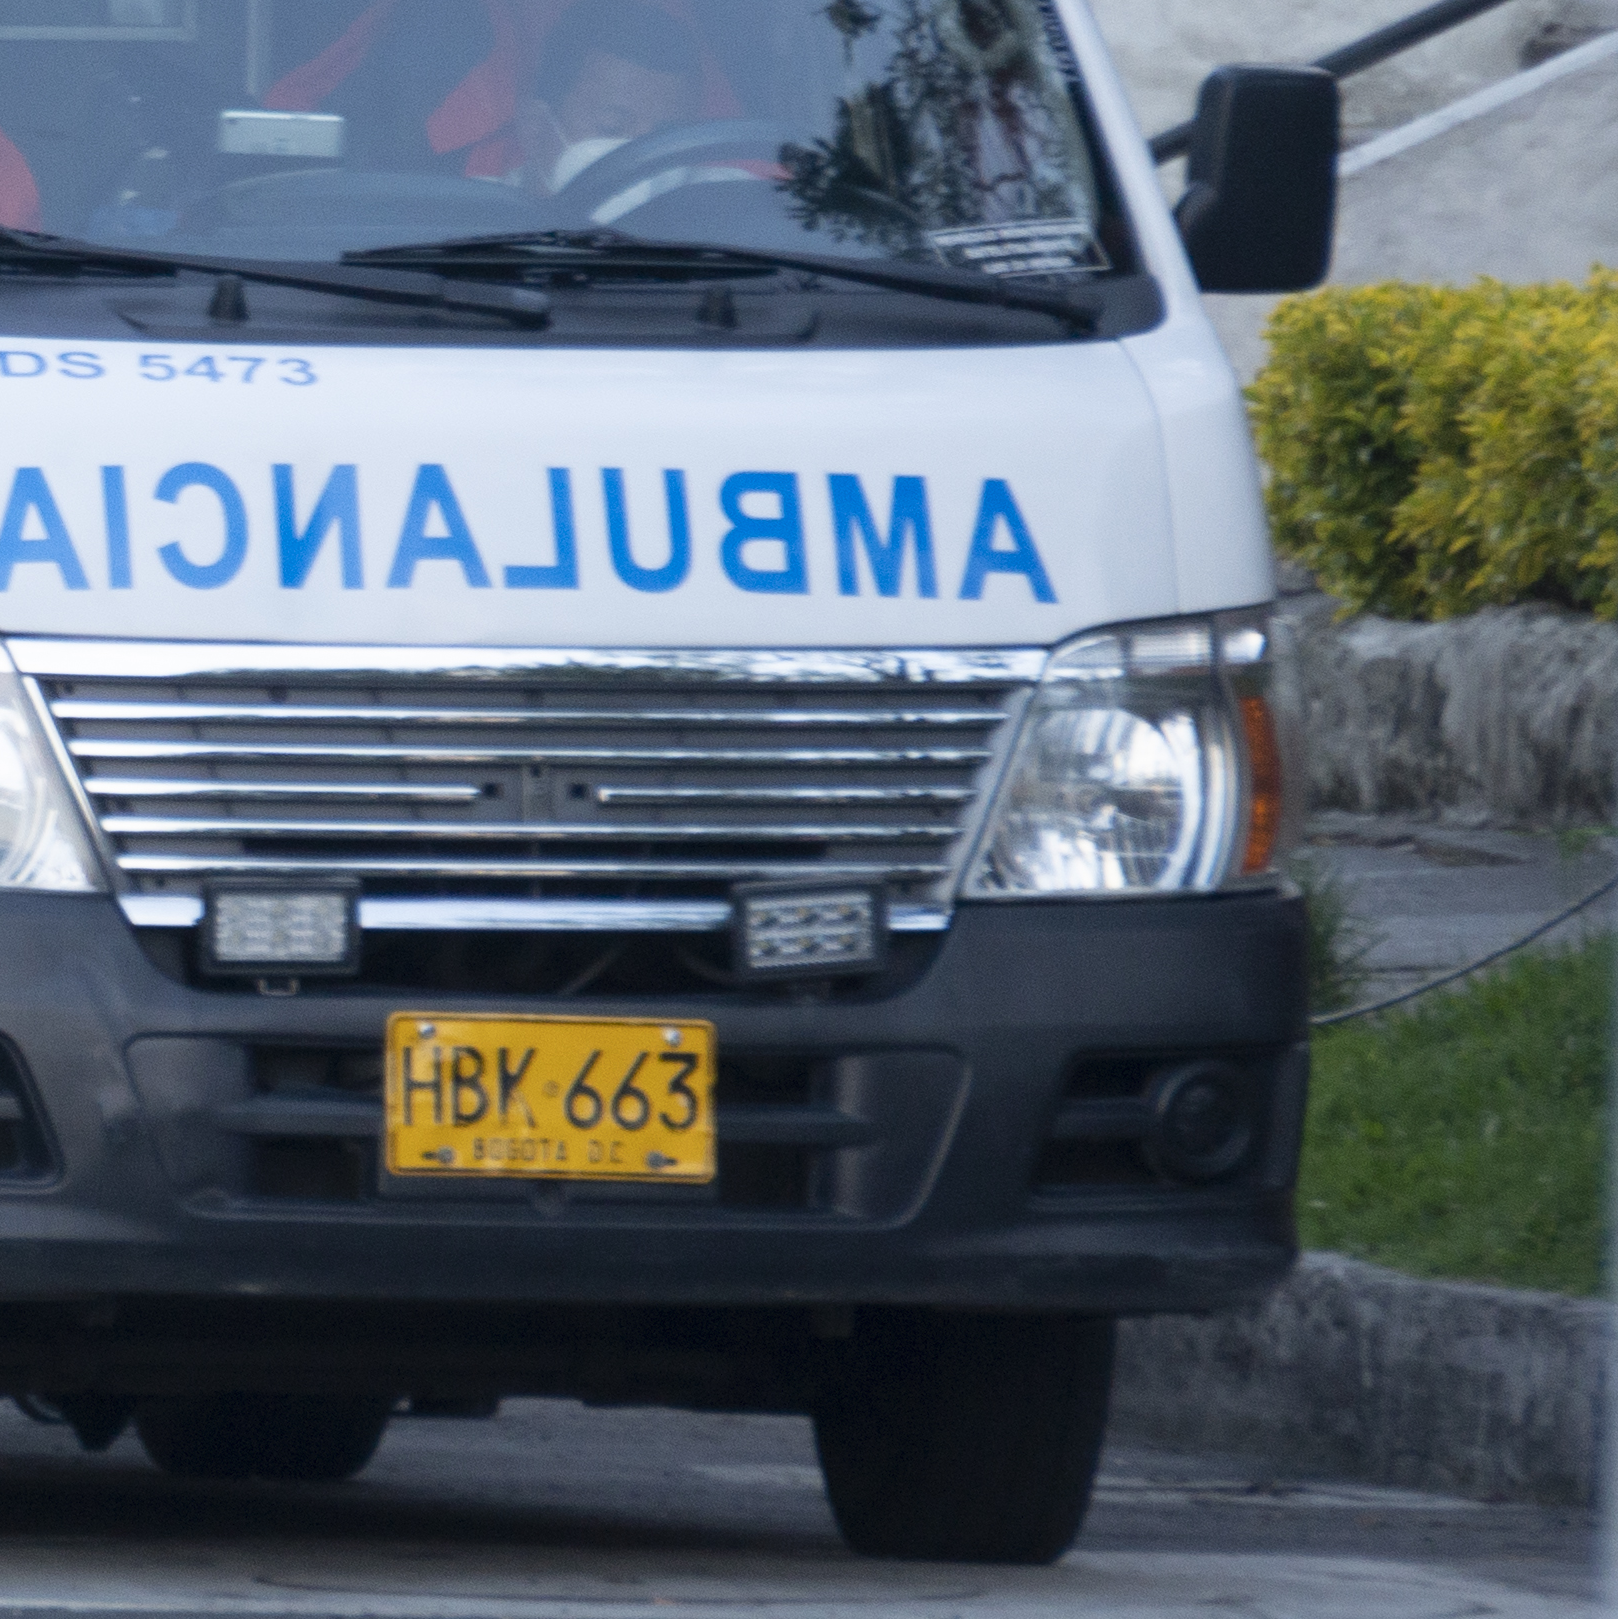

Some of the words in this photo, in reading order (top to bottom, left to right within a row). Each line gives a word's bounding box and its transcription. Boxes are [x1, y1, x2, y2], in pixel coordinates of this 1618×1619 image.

[138, 354, 317, 386] 5473
[402, 1045, 537, 1128] HBK
[563, 1048, 700, 1131] 663
